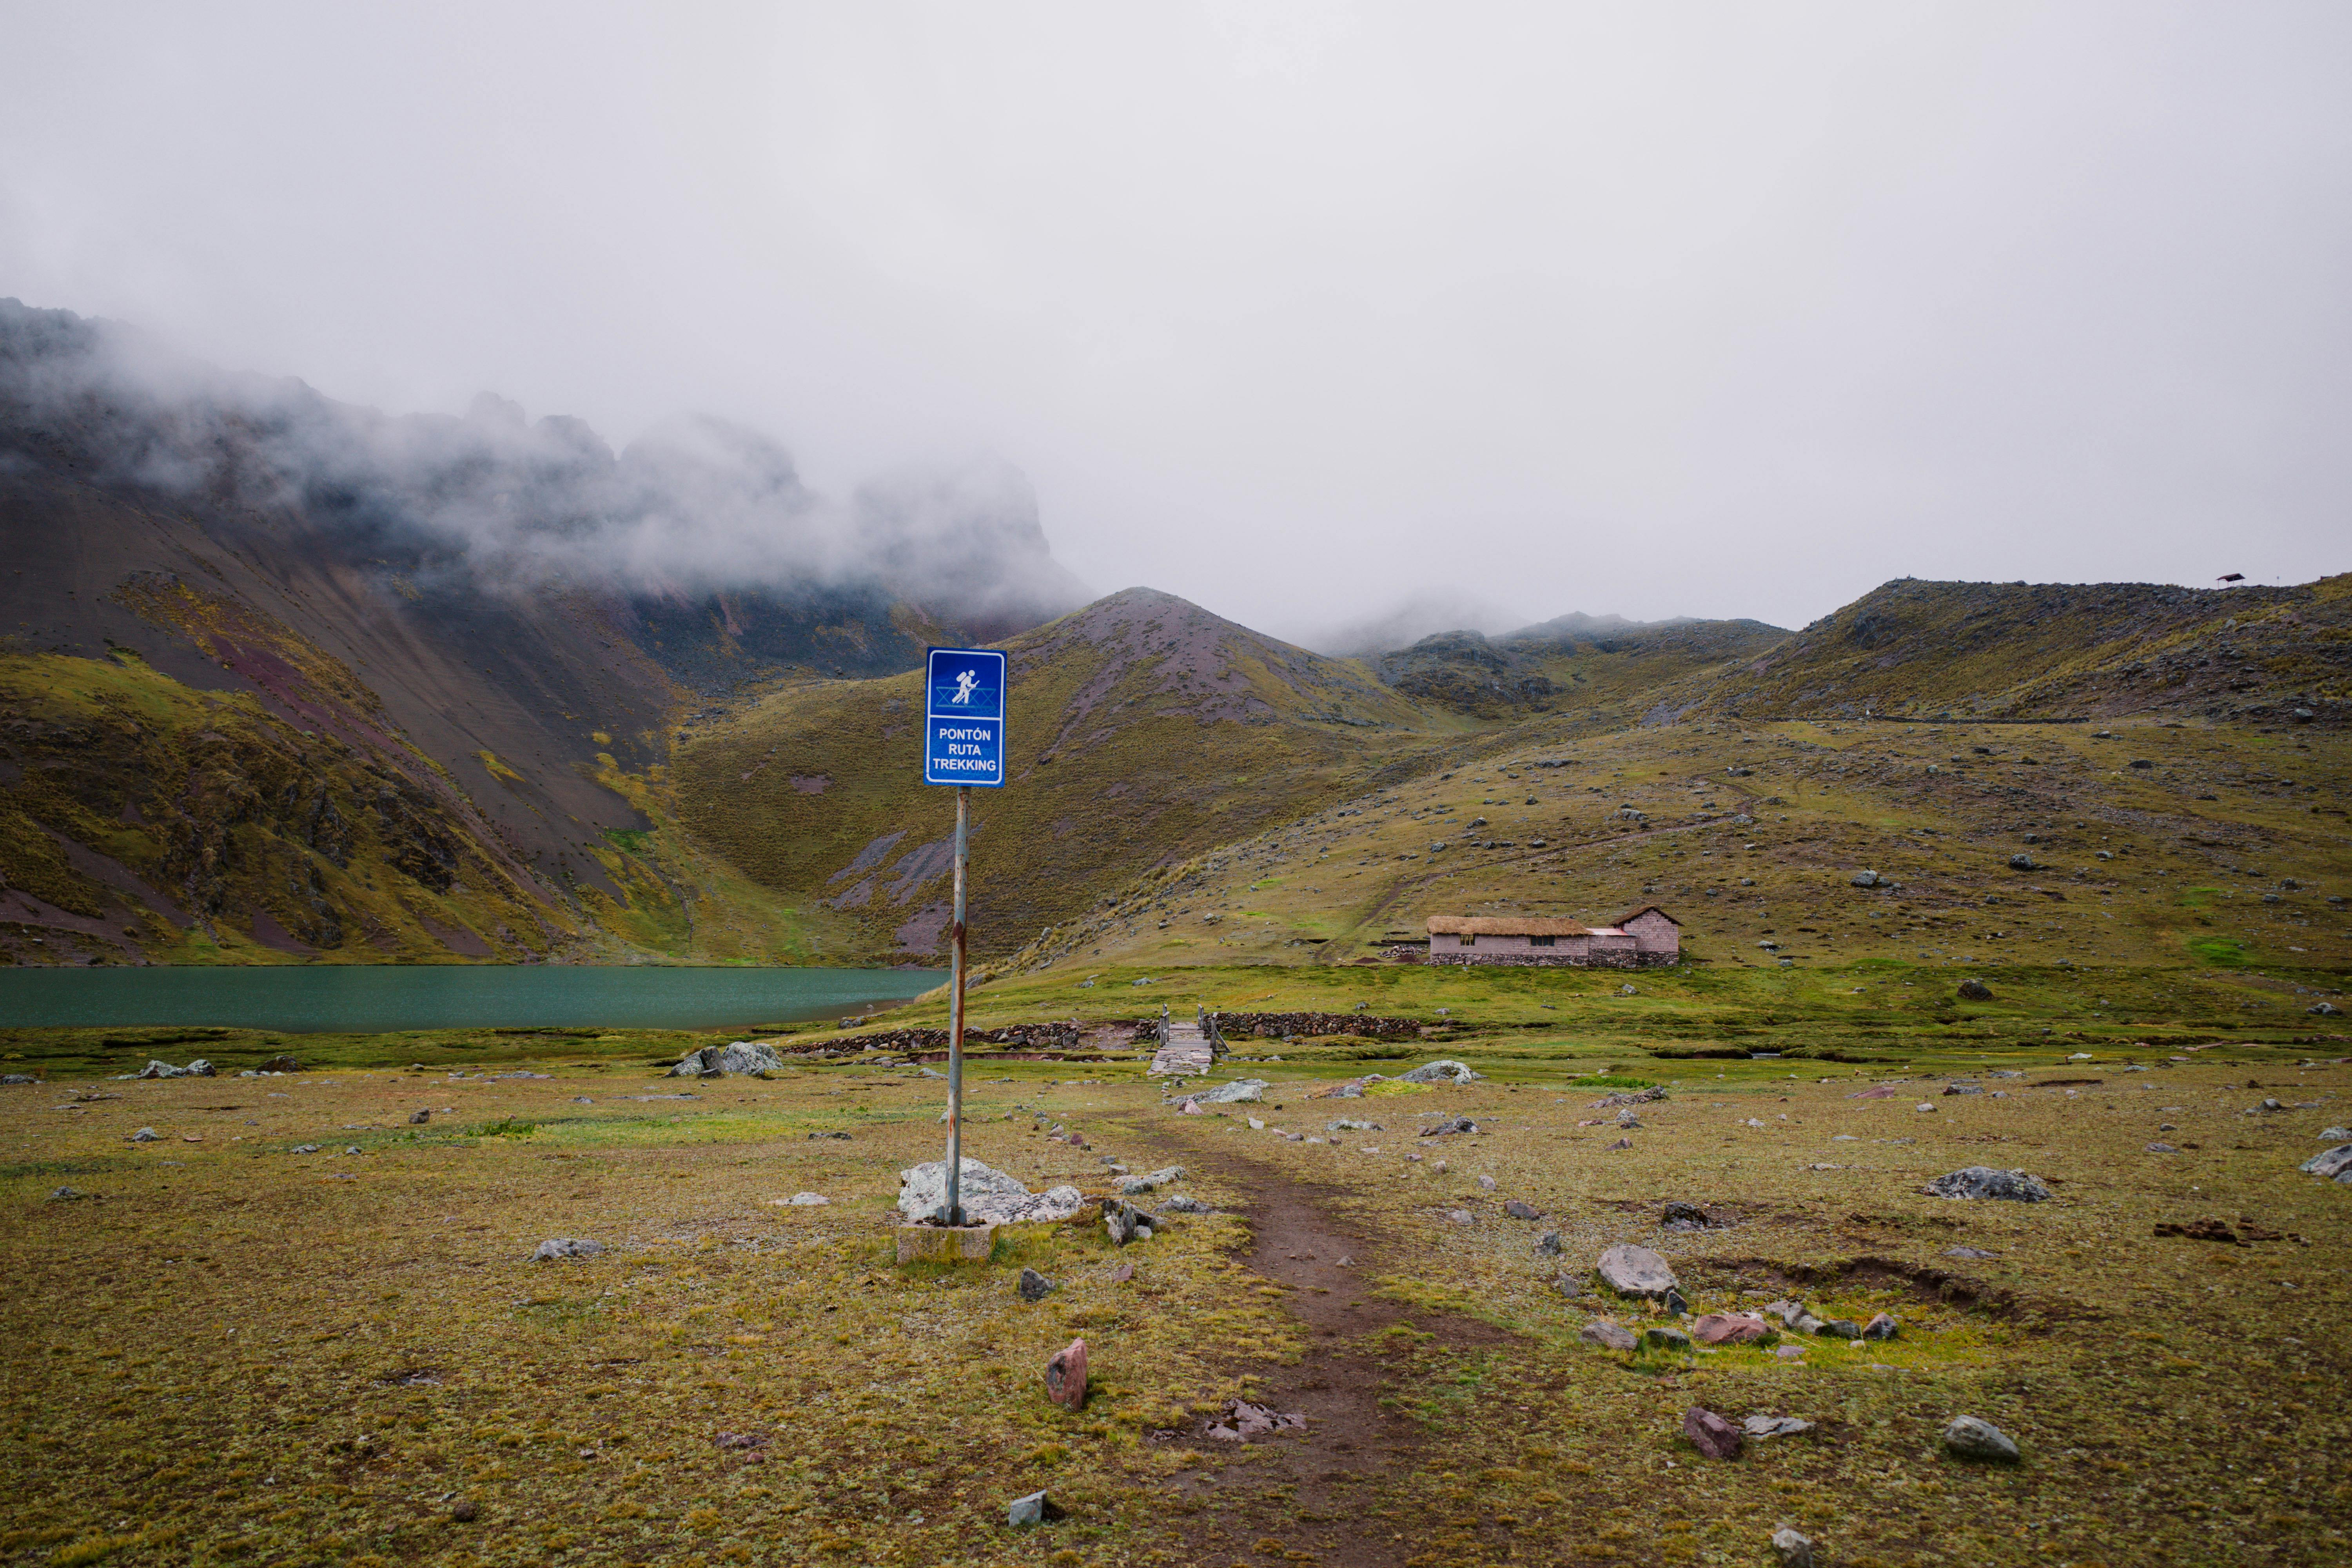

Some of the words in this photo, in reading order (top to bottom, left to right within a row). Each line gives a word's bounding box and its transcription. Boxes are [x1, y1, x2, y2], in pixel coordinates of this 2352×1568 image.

[939, 727, 991, 740] PONTÓN
[949, 744, 981, 755] RUTA
[933, 758, 996, 771] TREKKING
